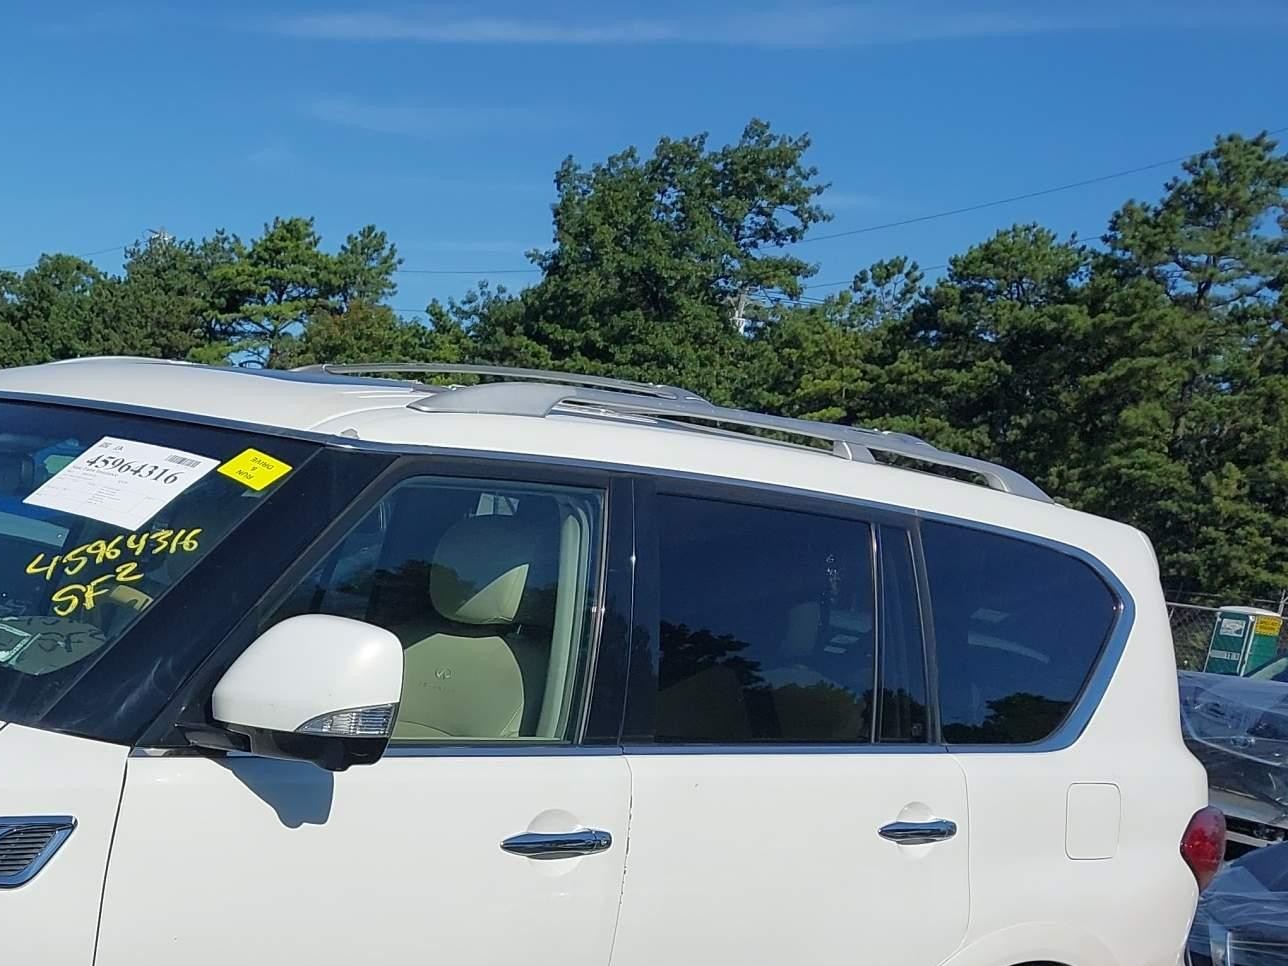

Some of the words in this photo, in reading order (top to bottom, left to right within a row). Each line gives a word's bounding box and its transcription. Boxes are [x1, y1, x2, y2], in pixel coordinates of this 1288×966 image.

[86, 454, 185, 485] 45964316
[250, 456, 274, 470] DRIVE
[236, 469, 256, 480] RUN
[26, 528, 202, 580] 45964316
